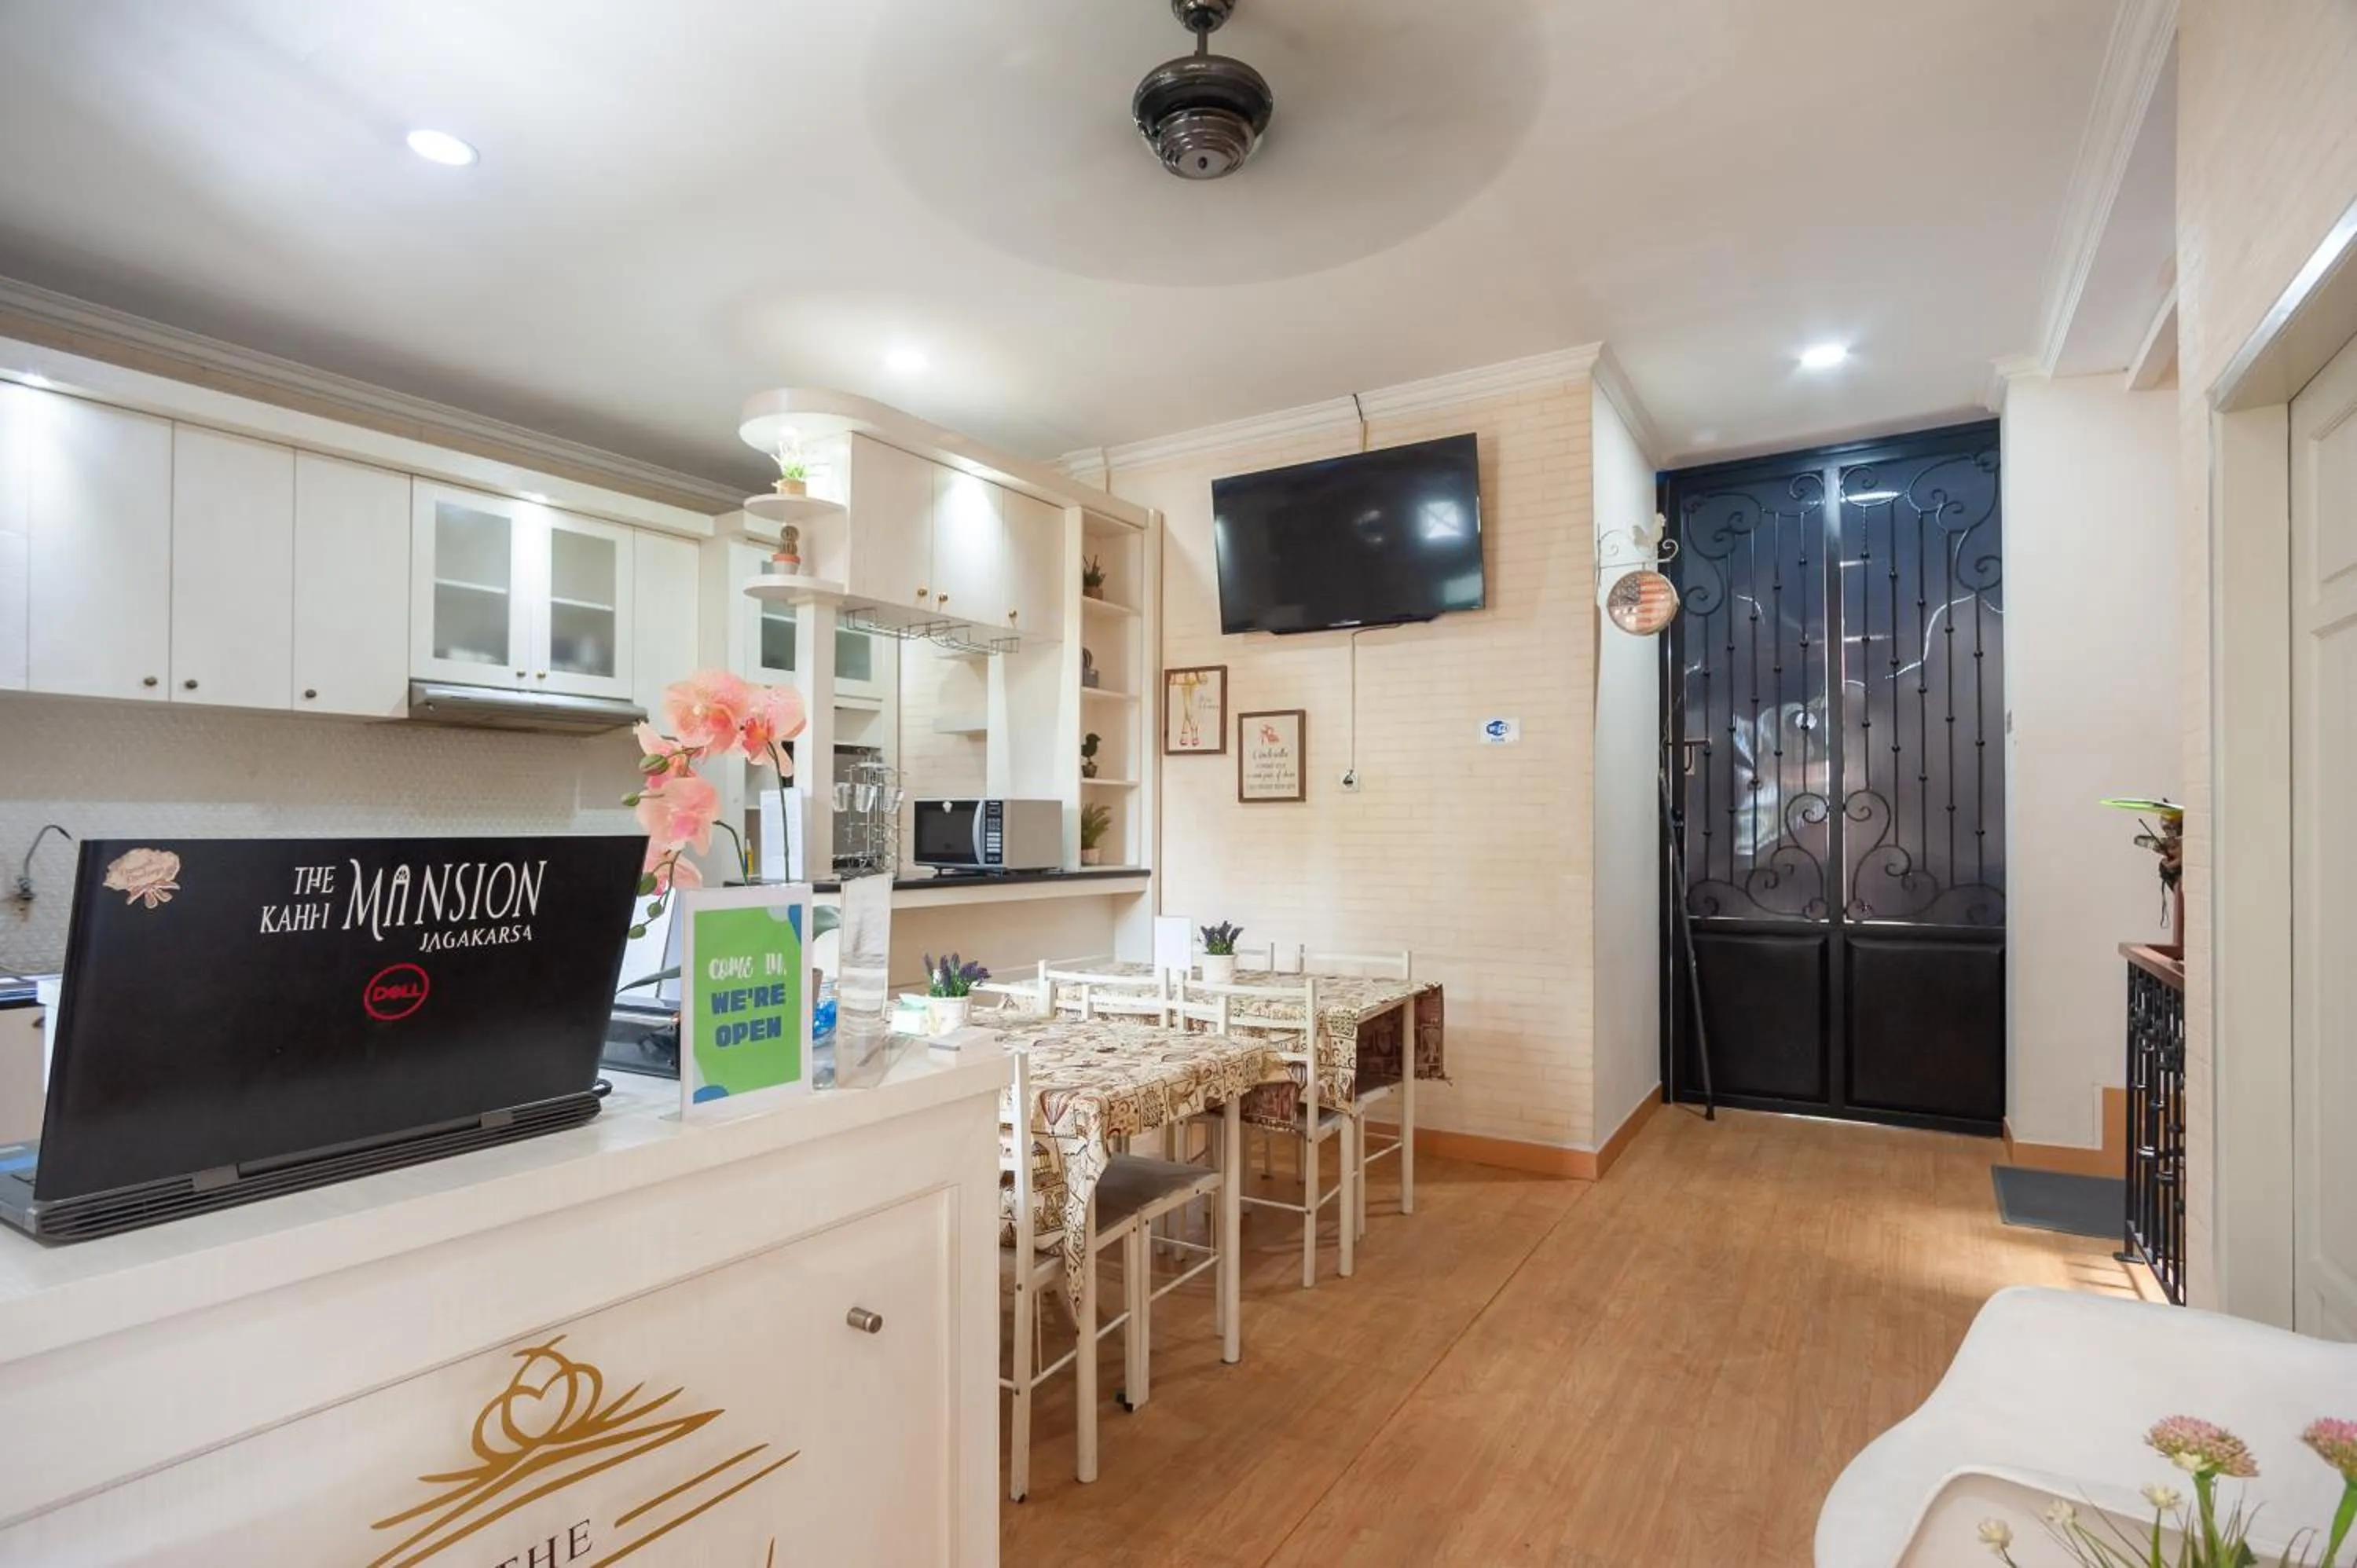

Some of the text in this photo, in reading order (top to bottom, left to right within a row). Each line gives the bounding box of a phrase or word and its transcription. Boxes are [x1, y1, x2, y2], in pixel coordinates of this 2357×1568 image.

[293, 866, 336, 895] THE
[341, 859, 547, 942] MANSION
[419, 924, 533, 953] JAGAKARSA
[709, 956, 753, 980] COME
[372, 983, 422, 1002] DELL
[711, 983, 786, 1015] WE'RE
[715, 1016, 782, 1048] OPEN
